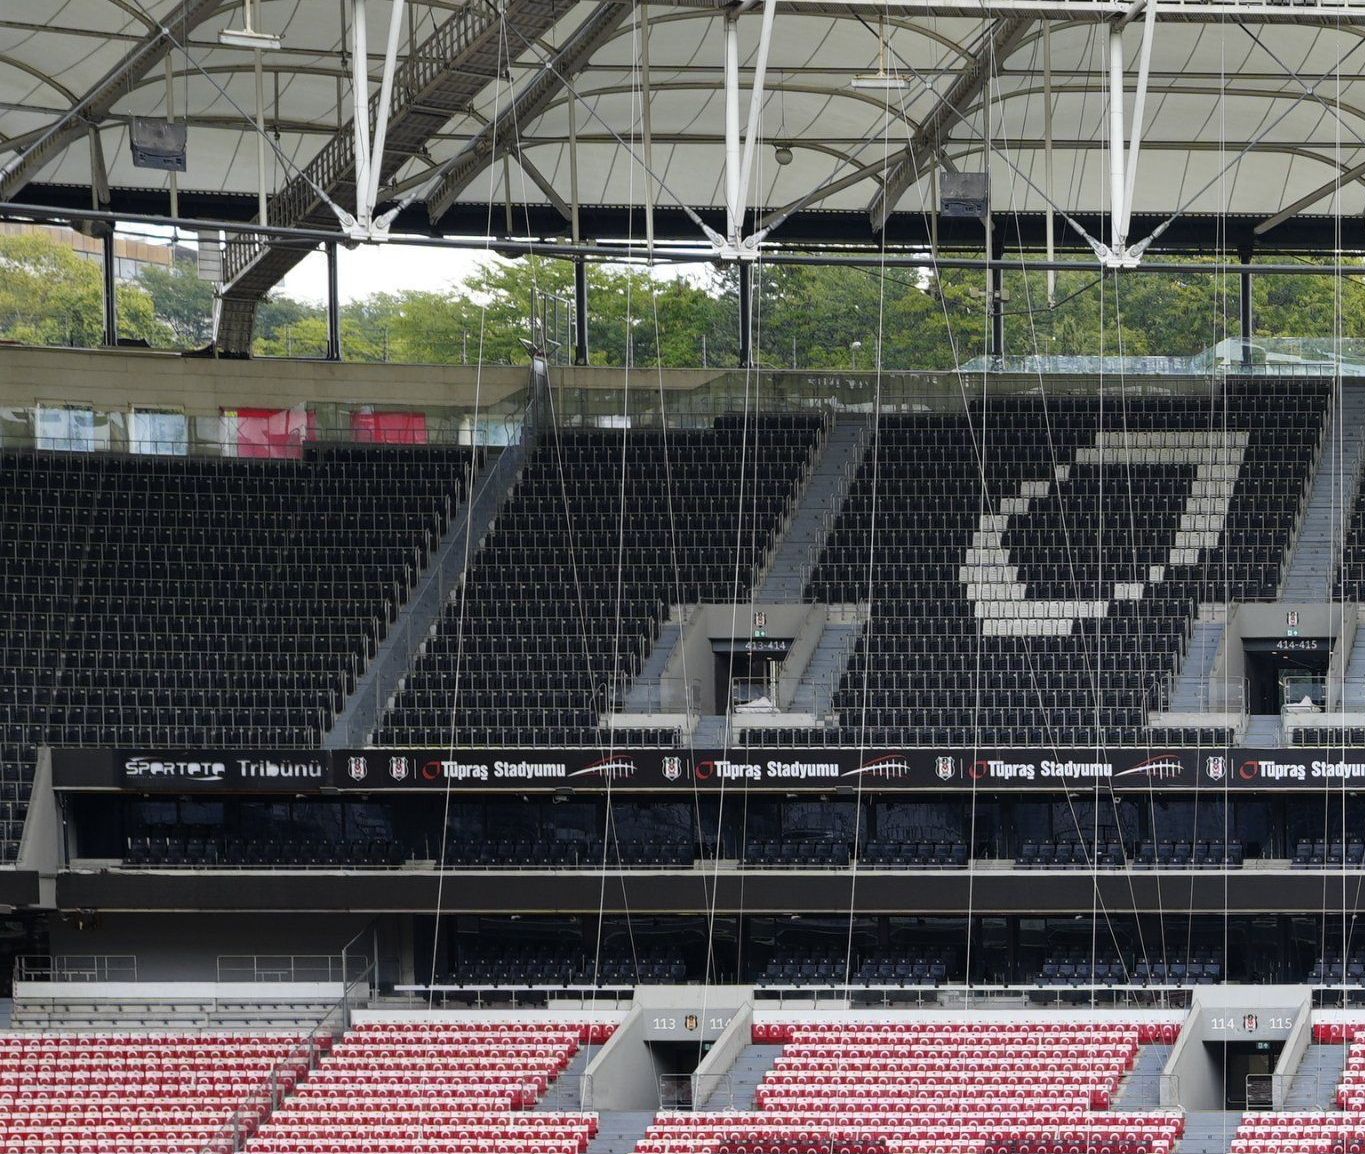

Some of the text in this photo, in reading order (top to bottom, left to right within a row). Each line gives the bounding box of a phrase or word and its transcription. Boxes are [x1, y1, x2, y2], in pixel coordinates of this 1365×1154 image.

[1276, 640, 1317, 649] 414-415
[237, 760, 322, 777] Tribünü
[440, 761, 567, 780] Tüpraş Stadyumu
[713, 761, 839, 780] Tüpraş Stadyumu
[987, 761, 1113, 780] Tüpraş Stadyumu
[1258, 761, 1306, 780] Tüpraş
[653, 1017, 676, 1029] 113
[1211, 1017, 1235, 1029] 114
[1269, 1017, 1292, 1029] 115
